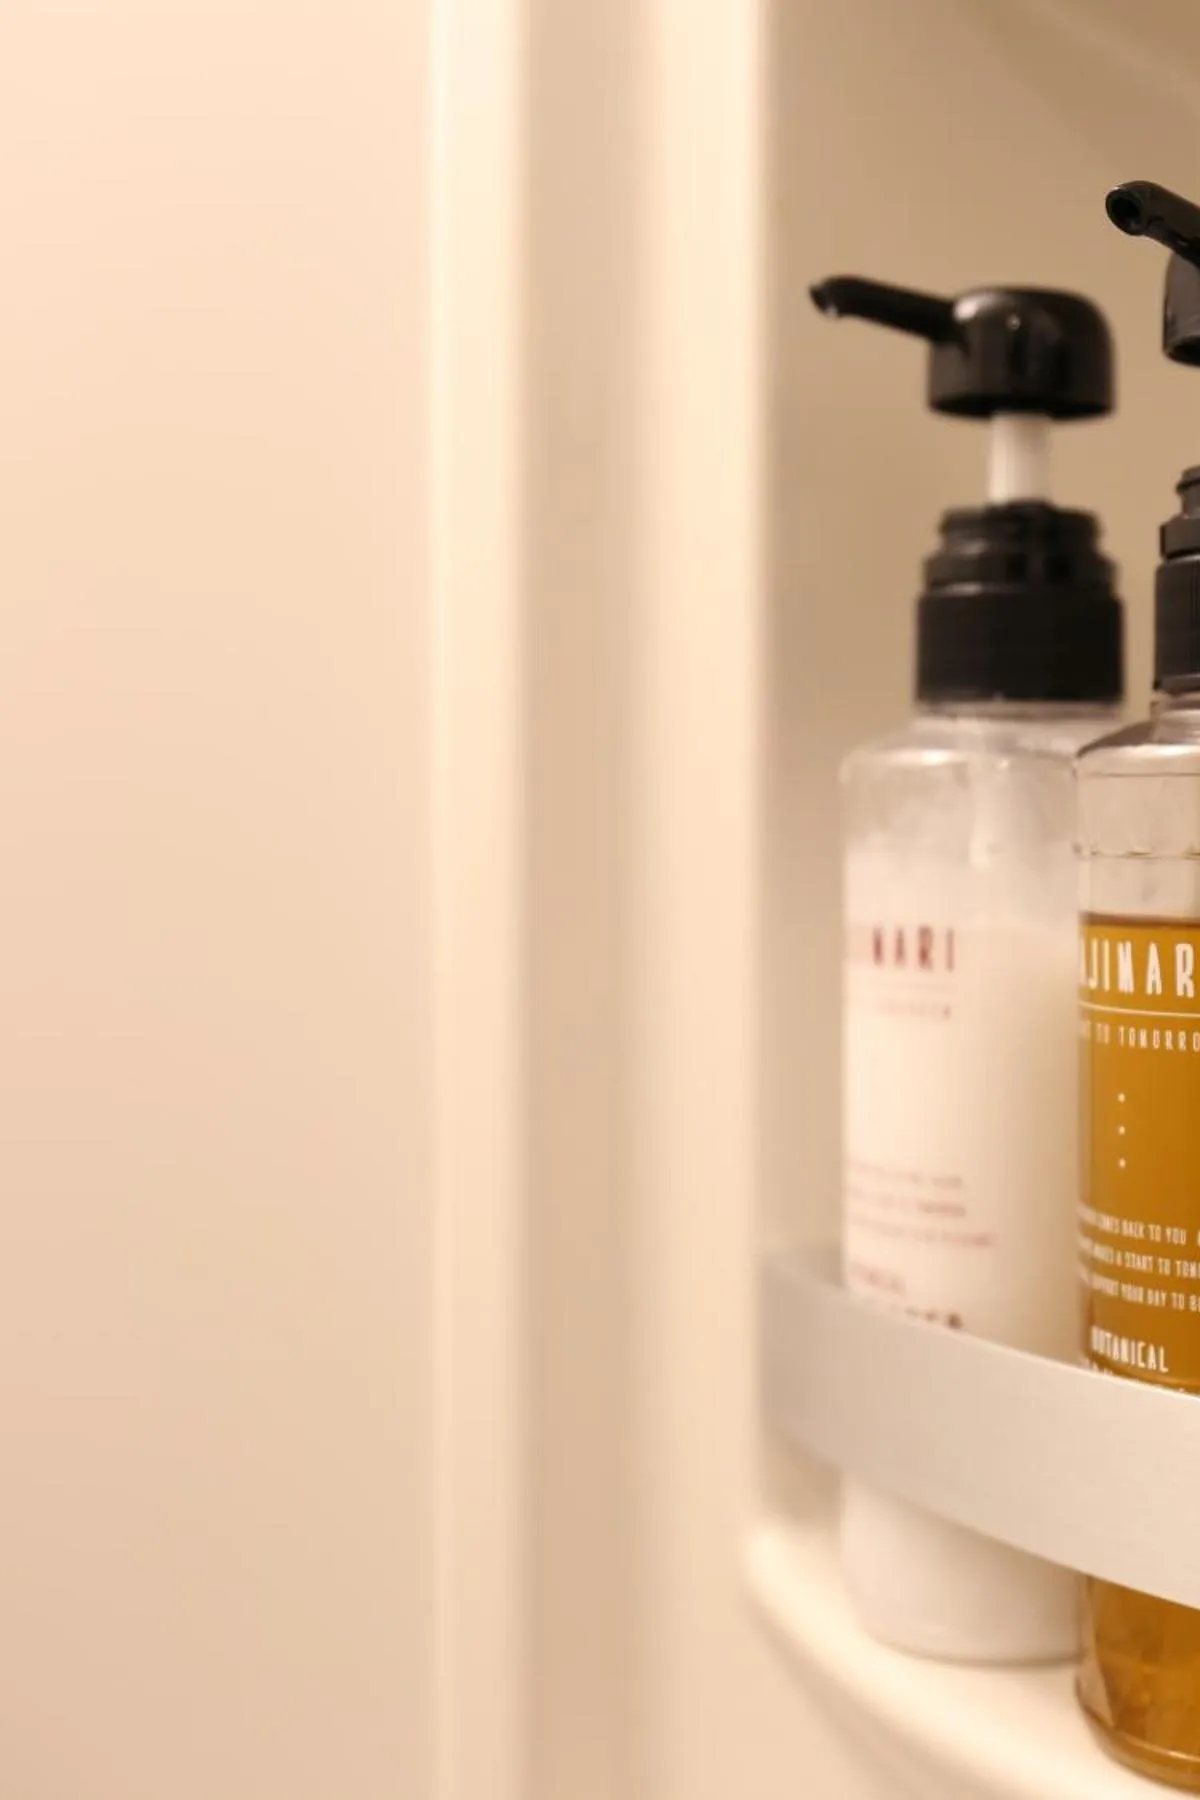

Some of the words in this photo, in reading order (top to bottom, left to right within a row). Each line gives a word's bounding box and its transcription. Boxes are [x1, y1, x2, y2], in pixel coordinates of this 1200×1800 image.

[1149, 1224, 1161, 1243] TO
[1166, 1226, 1187, 1246] YOU
[1158, 1256, 1171, 1276] TO
[1147, 1289, 1167, 1308] DAY
[1172, 1292, 1185, 1311] TO
